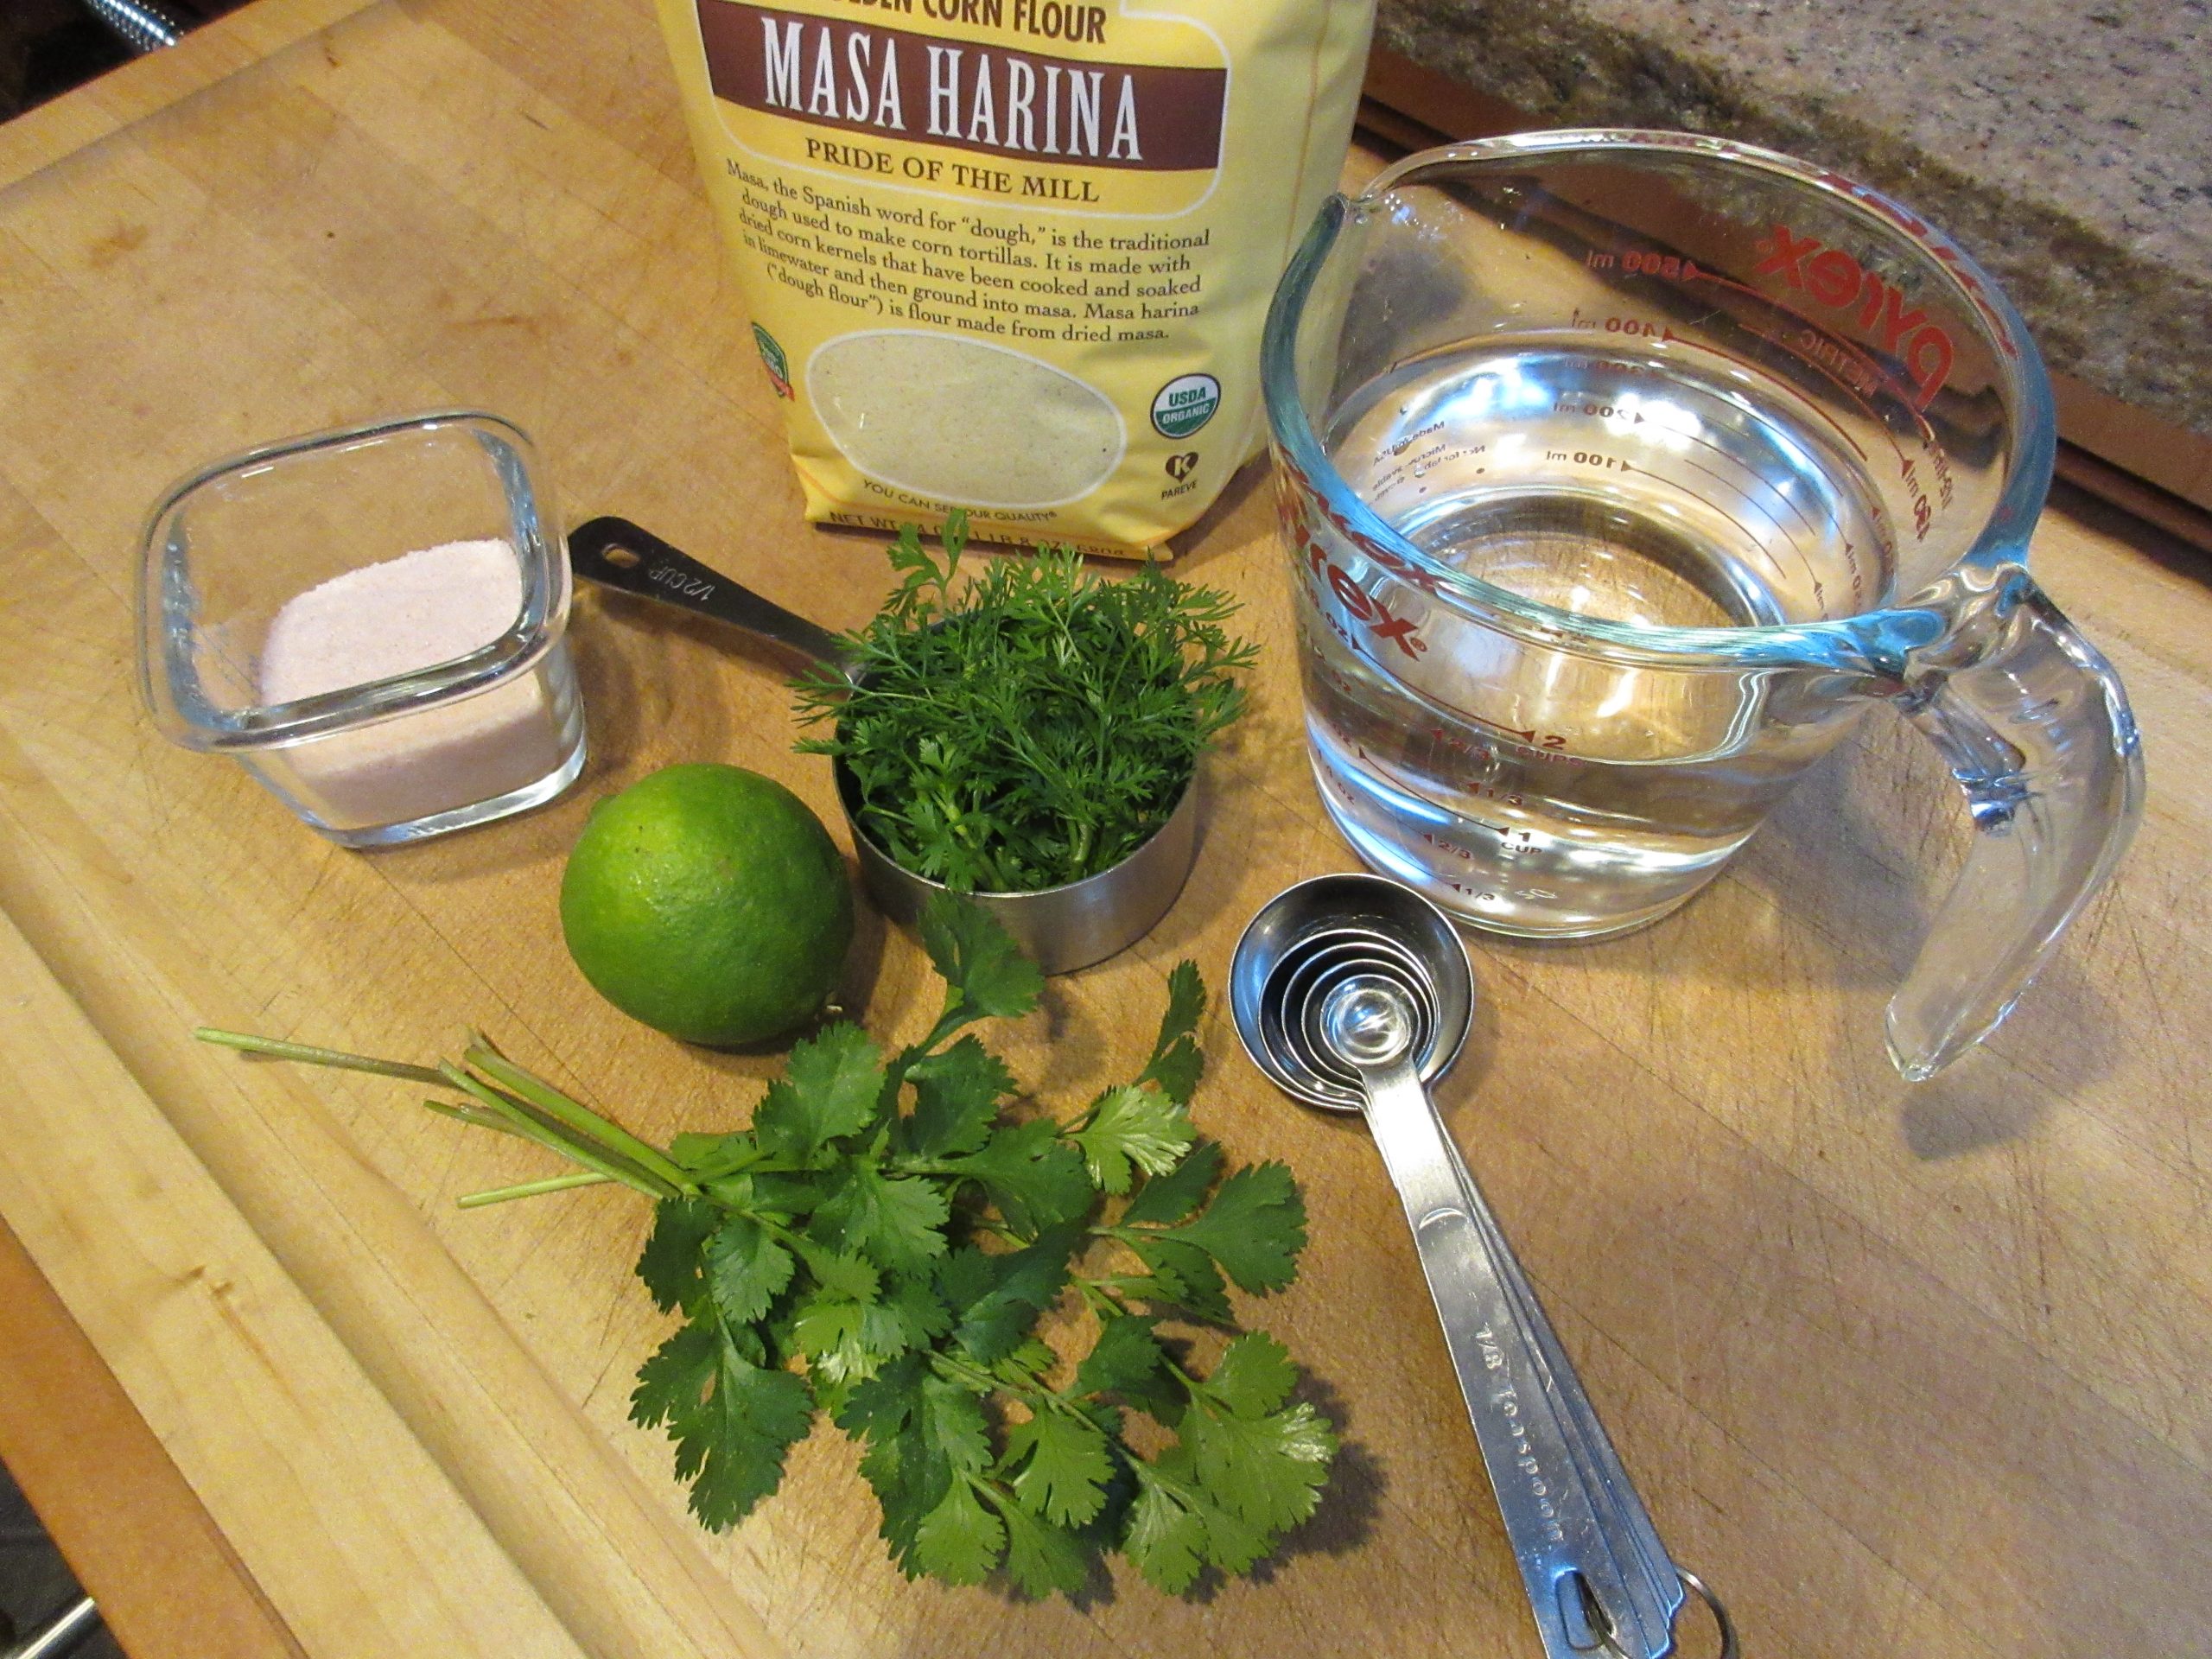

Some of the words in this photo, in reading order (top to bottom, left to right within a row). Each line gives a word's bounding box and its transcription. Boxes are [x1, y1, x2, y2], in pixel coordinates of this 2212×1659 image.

[1013, 2, 1107, 44] FLOUR
[760, 17, 906, 132] MASA
[925, 45, 1143, 162] HARINA
[806, 137, 894, 175] PRIDE
[902, 156, 944, 181] OF
[952, 165, 1013, 194] THE
[1021, 175, 1100, 203] MILL
[726, 157, 769, 191] Masa,
[773, 177, 798, 200] the
[803, 186, 871, 217] Spanish
[877, 208, 924, 226] word
[930, 211, 958, 232] for
[1051, 228, 1066, 247] is
[1073, 230, 1103, 249] the
[1109, 228, 1211, 251] traditional
[742, 188, 787, 223] dough
[792, 213, 830, 232] used
[836, 221, 853, 237] to
[859, 227, 906, 247] make
[912, 239, 952, 257] corn
[959, 247, 1038, 269] tortillas.
[1046, 254, 1061, 271] It
[1067, 255, 1082, 272] is
[1089, 257, 1142, 274] made
[1148, 254, 1191, 273] with
[739, 210, 772, 237] dried
[777, 228, 810, 249] corn
[816, 235, 877, 265] kernels
[882, 252, 917, 274] that
[923, 258, 966, 283] have
[971, 266, 1014, 289] been
[1020, 276, 1088, 296] cooked
[1095, 280, 1130, 297] and
[1136, 274, 1201, 297] soaked
[743, 228, 757, 249] in
[759, 235, 830, 276] limewater
[835, 269, 864, 286] and
[870, 272, 907, 295] then
[913, 287, 976, 308] ground
[983, 293, 1019, 313] into
[1025, 302, 1077, 319] masa.
[1084, 302, 1135, 320] Masa
[1141, 302, 1199, 320] harina
[889, 299, 903, 316] is
[908, 302, 951, 326] flour
[957, 316, 1006, 334] made
[1012, 320, 1055, 340] from
[1062, 324, 1111, 341] dried
[1117, 327, 1170, 342] masa.
[1162, 403, 1211, 424] ORGANIC
[1169, 386, 1207, 408] USDA
[864, 479, 894, 499] YOU
[899, 493, 930, 510] CAN
[1161, 480, 1198, 501] PAREVE
[1542, 734, 1567, 750] 2
[1438, 839, 1474, 860] 2/3
[1501, 841, 1542, 855] CUP
[1517, 831, 1530, 842] 1
[1465, 887, 1496, 900] 1/3
[1497, 1384, 1564, 1541] Teaspoon
